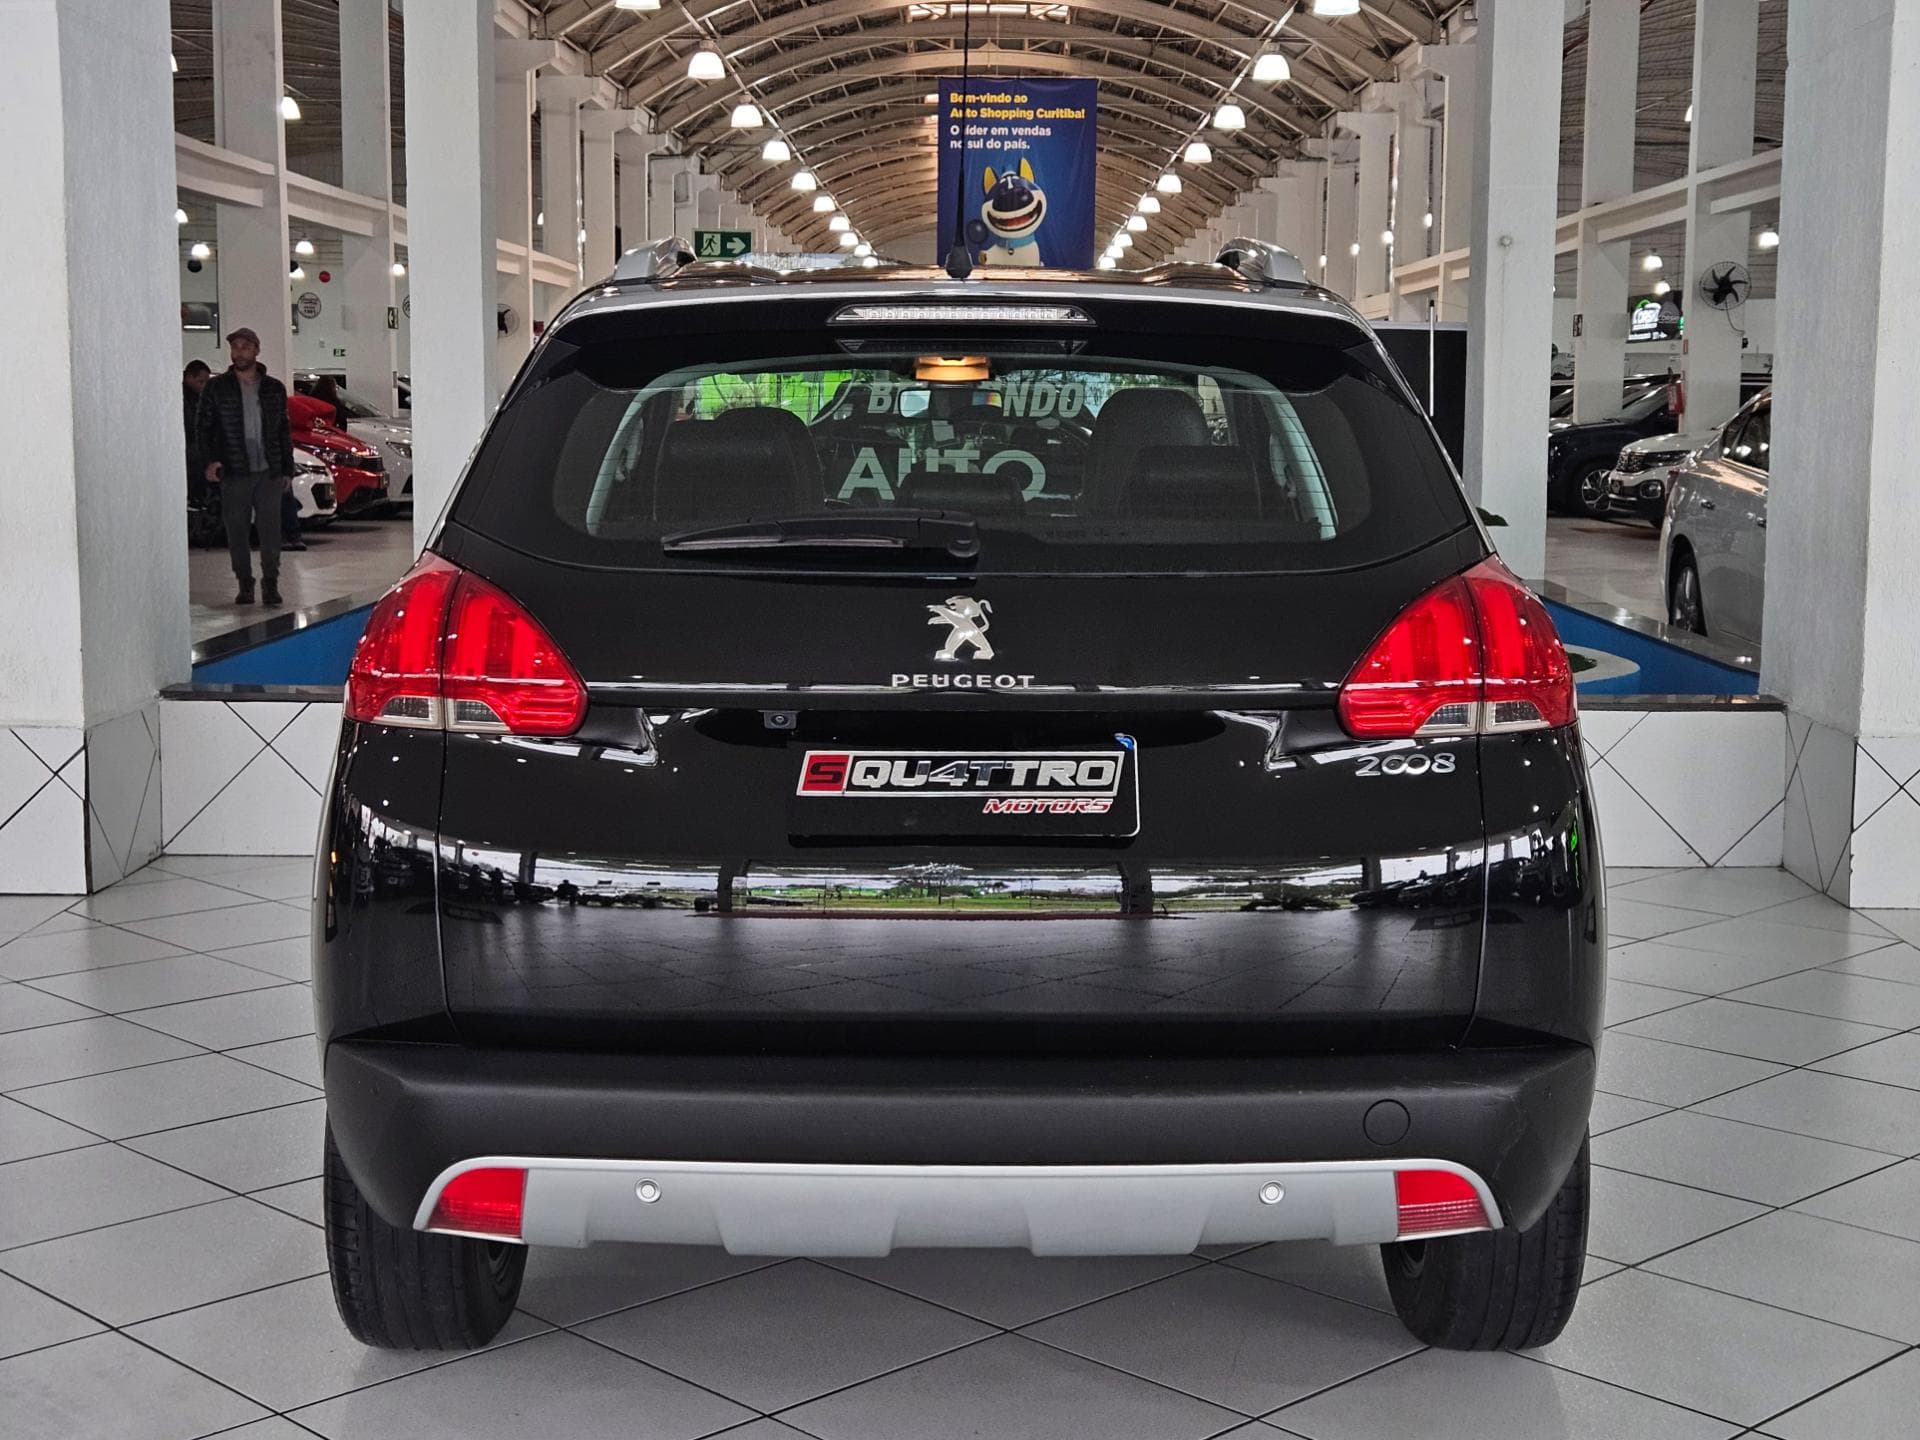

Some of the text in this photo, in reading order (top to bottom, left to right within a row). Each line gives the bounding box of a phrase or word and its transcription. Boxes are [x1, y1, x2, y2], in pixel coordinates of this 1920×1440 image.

[1013, 94, 1028, 103] ao
[980, 107, 1034, 120] Shopping
[1036, 107, 1086, 119] Curitiba!
[950, 125, 1052, 136] O íder em vendas
[967, 138, 984, 149] sul
[986, 138, 1002, 149] do
[1004, 138, 1031, 151] país.
[891, 673, 1036, 689] PEUGEOT
[1355, 752, 1456, 777] 2008
[982, 798, 1114, 814] MOTORS
